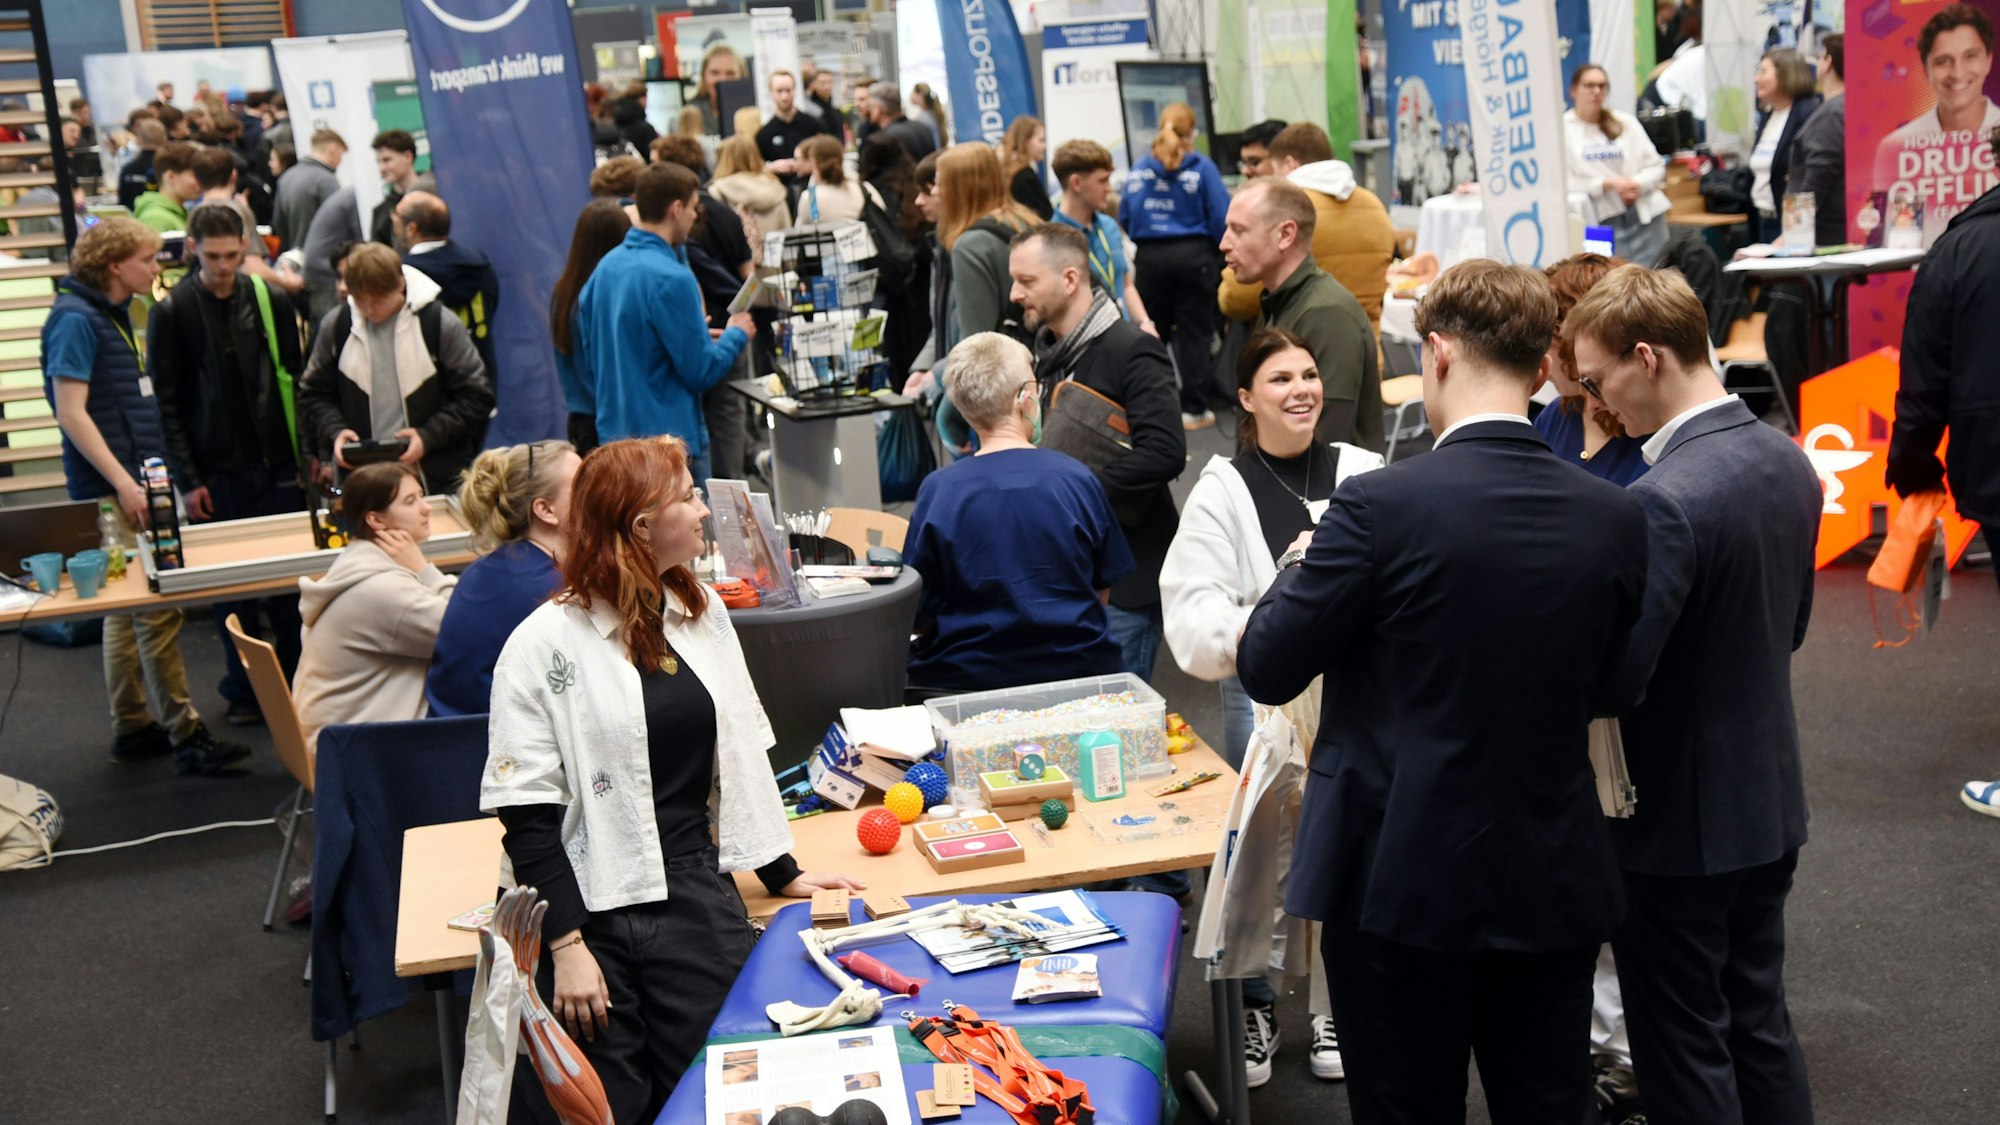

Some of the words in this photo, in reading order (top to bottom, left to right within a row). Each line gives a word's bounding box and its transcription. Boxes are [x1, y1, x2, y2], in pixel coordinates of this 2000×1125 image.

[1411, 2, 1442, 29] MIT
[1904, 132, 1947, 149] HOW
[1951, 128, 1973, 145] TO
[1899, 141, 1996, 179] DRUG
